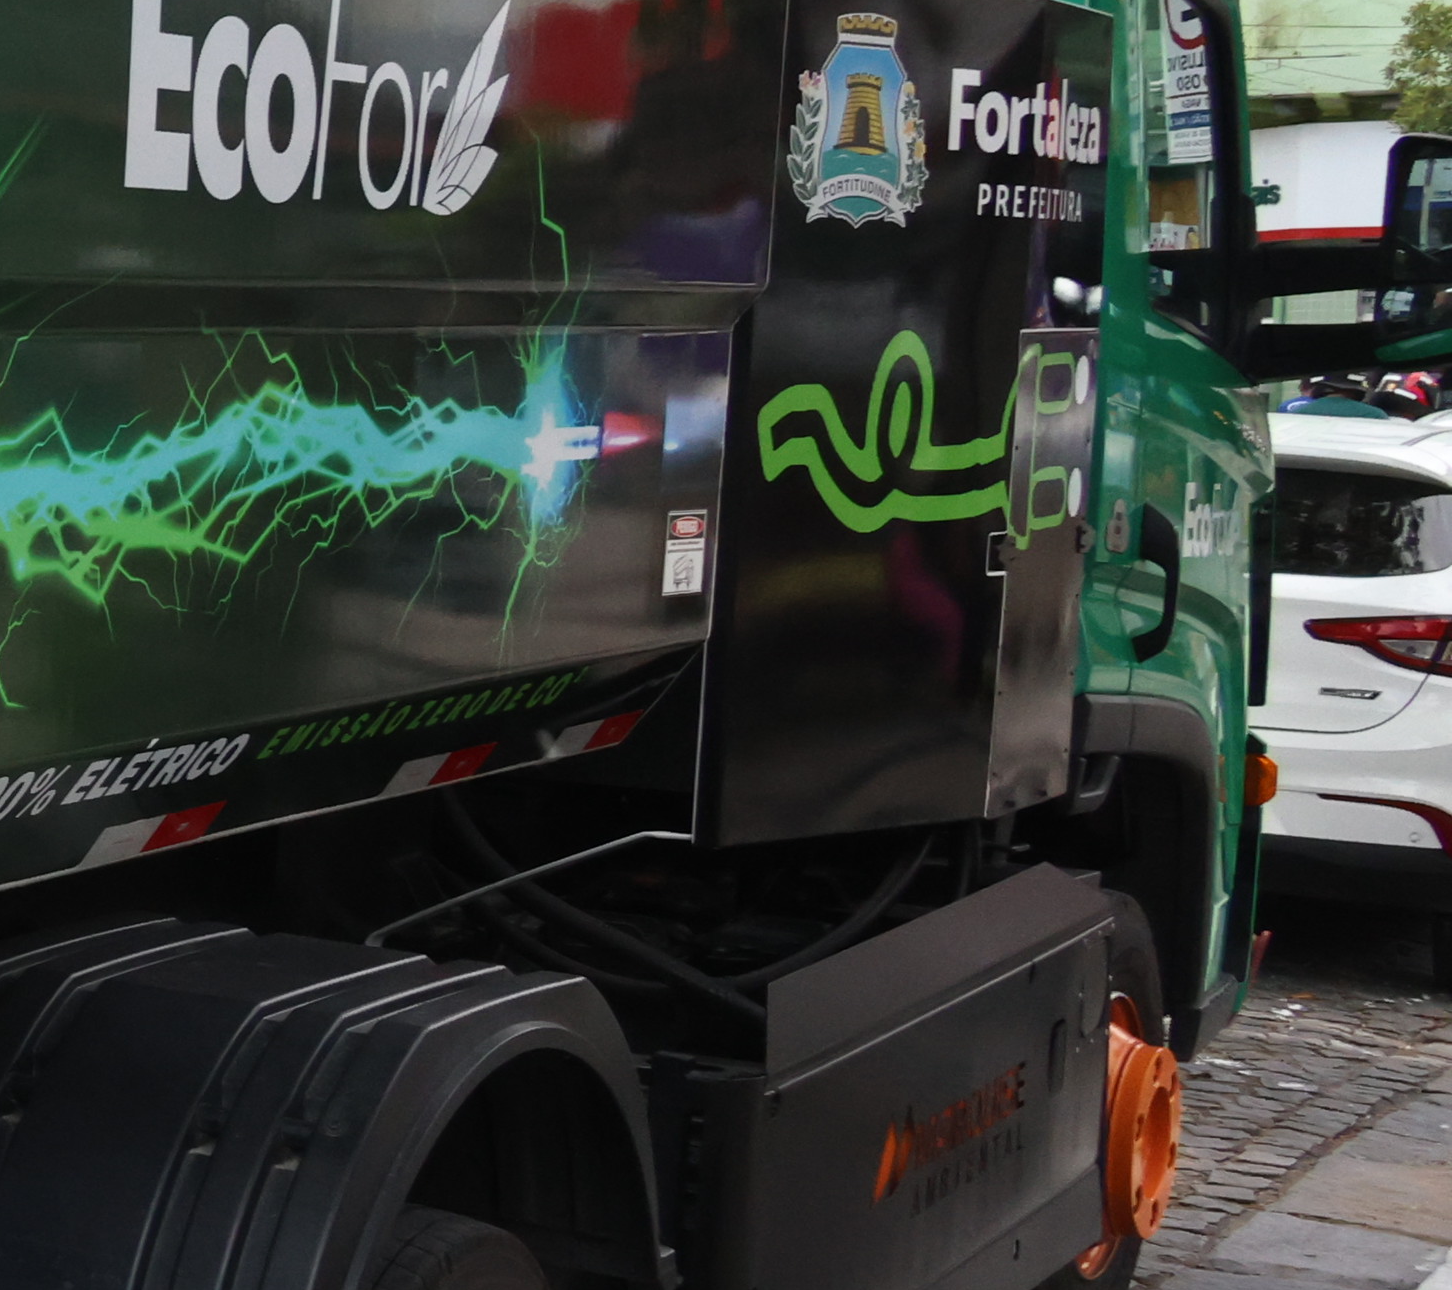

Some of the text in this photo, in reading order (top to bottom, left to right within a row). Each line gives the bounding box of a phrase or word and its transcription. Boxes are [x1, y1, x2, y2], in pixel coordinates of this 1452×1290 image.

[948, 68, 1101, 165] Fortaleza
[822, 178, 892, 204] FORTITUDINE
[976, 182, 1083, 222] PREFEITURA
[59, 733, 252, 805] ELÉTRICO
[257, 701, 411, 759] EMISSÃO
[405, 689, 492, 730] ZERO
[484, 683, 533, 715] DE
